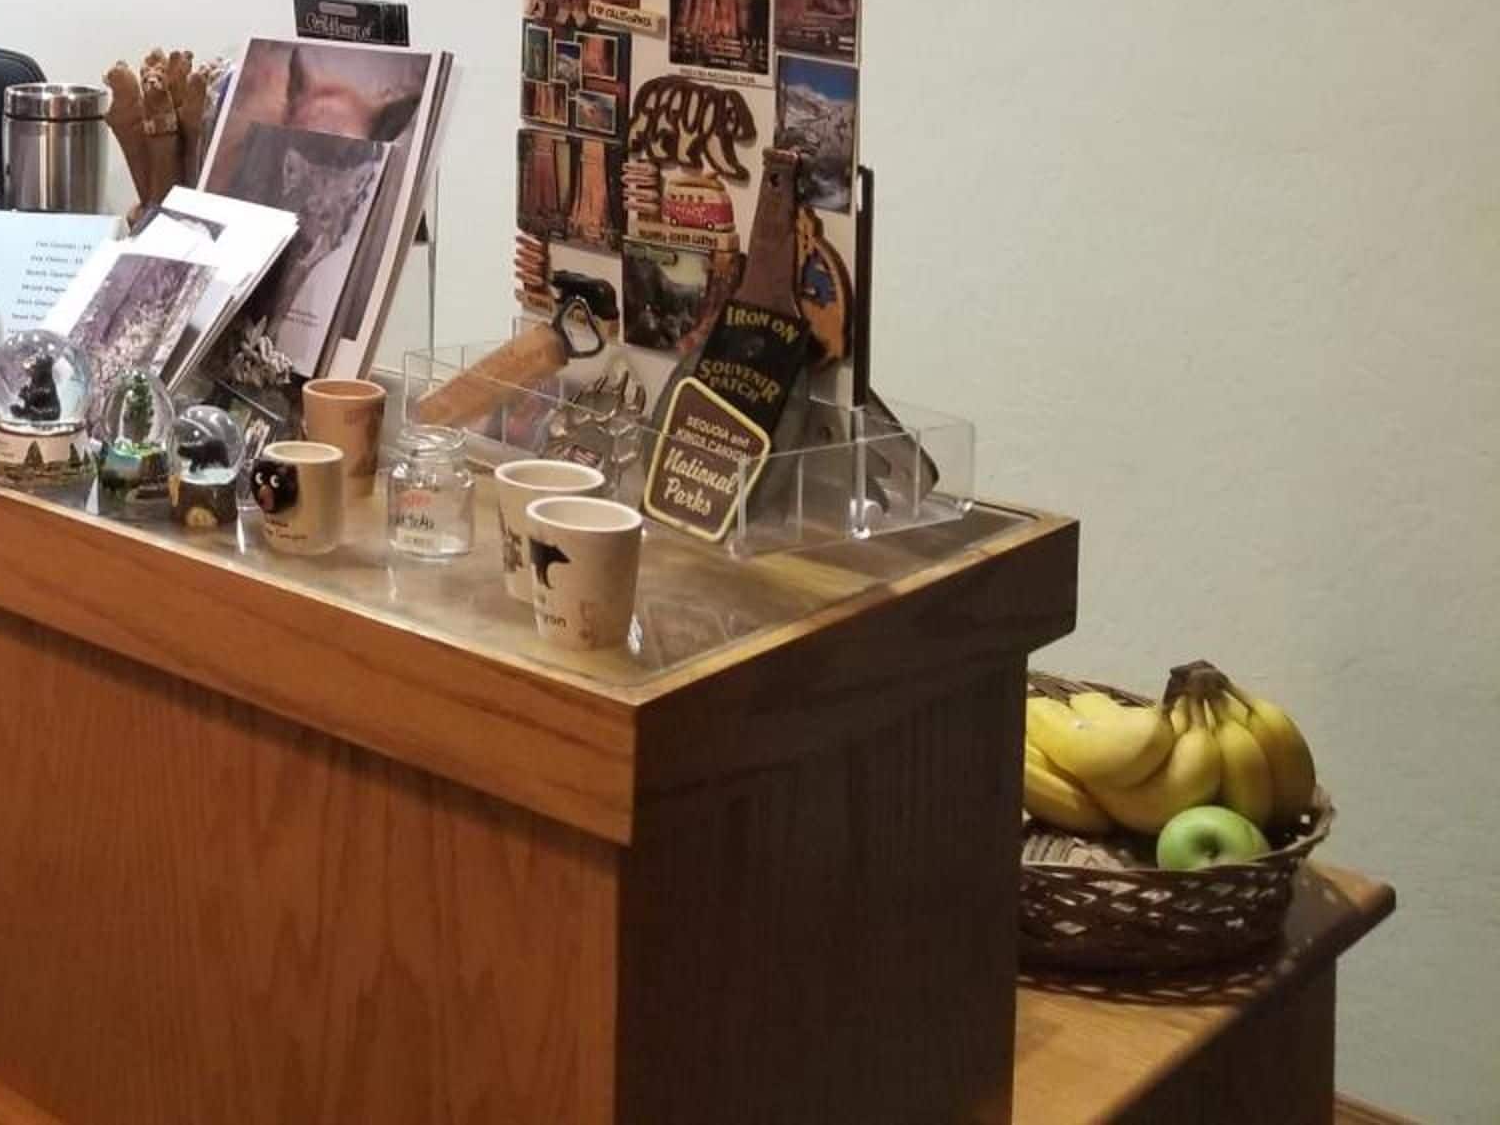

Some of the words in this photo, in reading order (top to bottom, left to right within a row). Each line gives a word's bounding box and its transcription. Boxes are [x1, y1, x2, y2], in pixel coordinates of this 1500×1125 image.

[726, 305, 770, 328] IRON
[771, 319, 800, 345] ON
[699, 359, 782, 405] SOUVENIR
[686, 415, 729, 440] SEQUOIA
[663, 446, 740, 496] National
[663, 477, 712, 517] Parks
